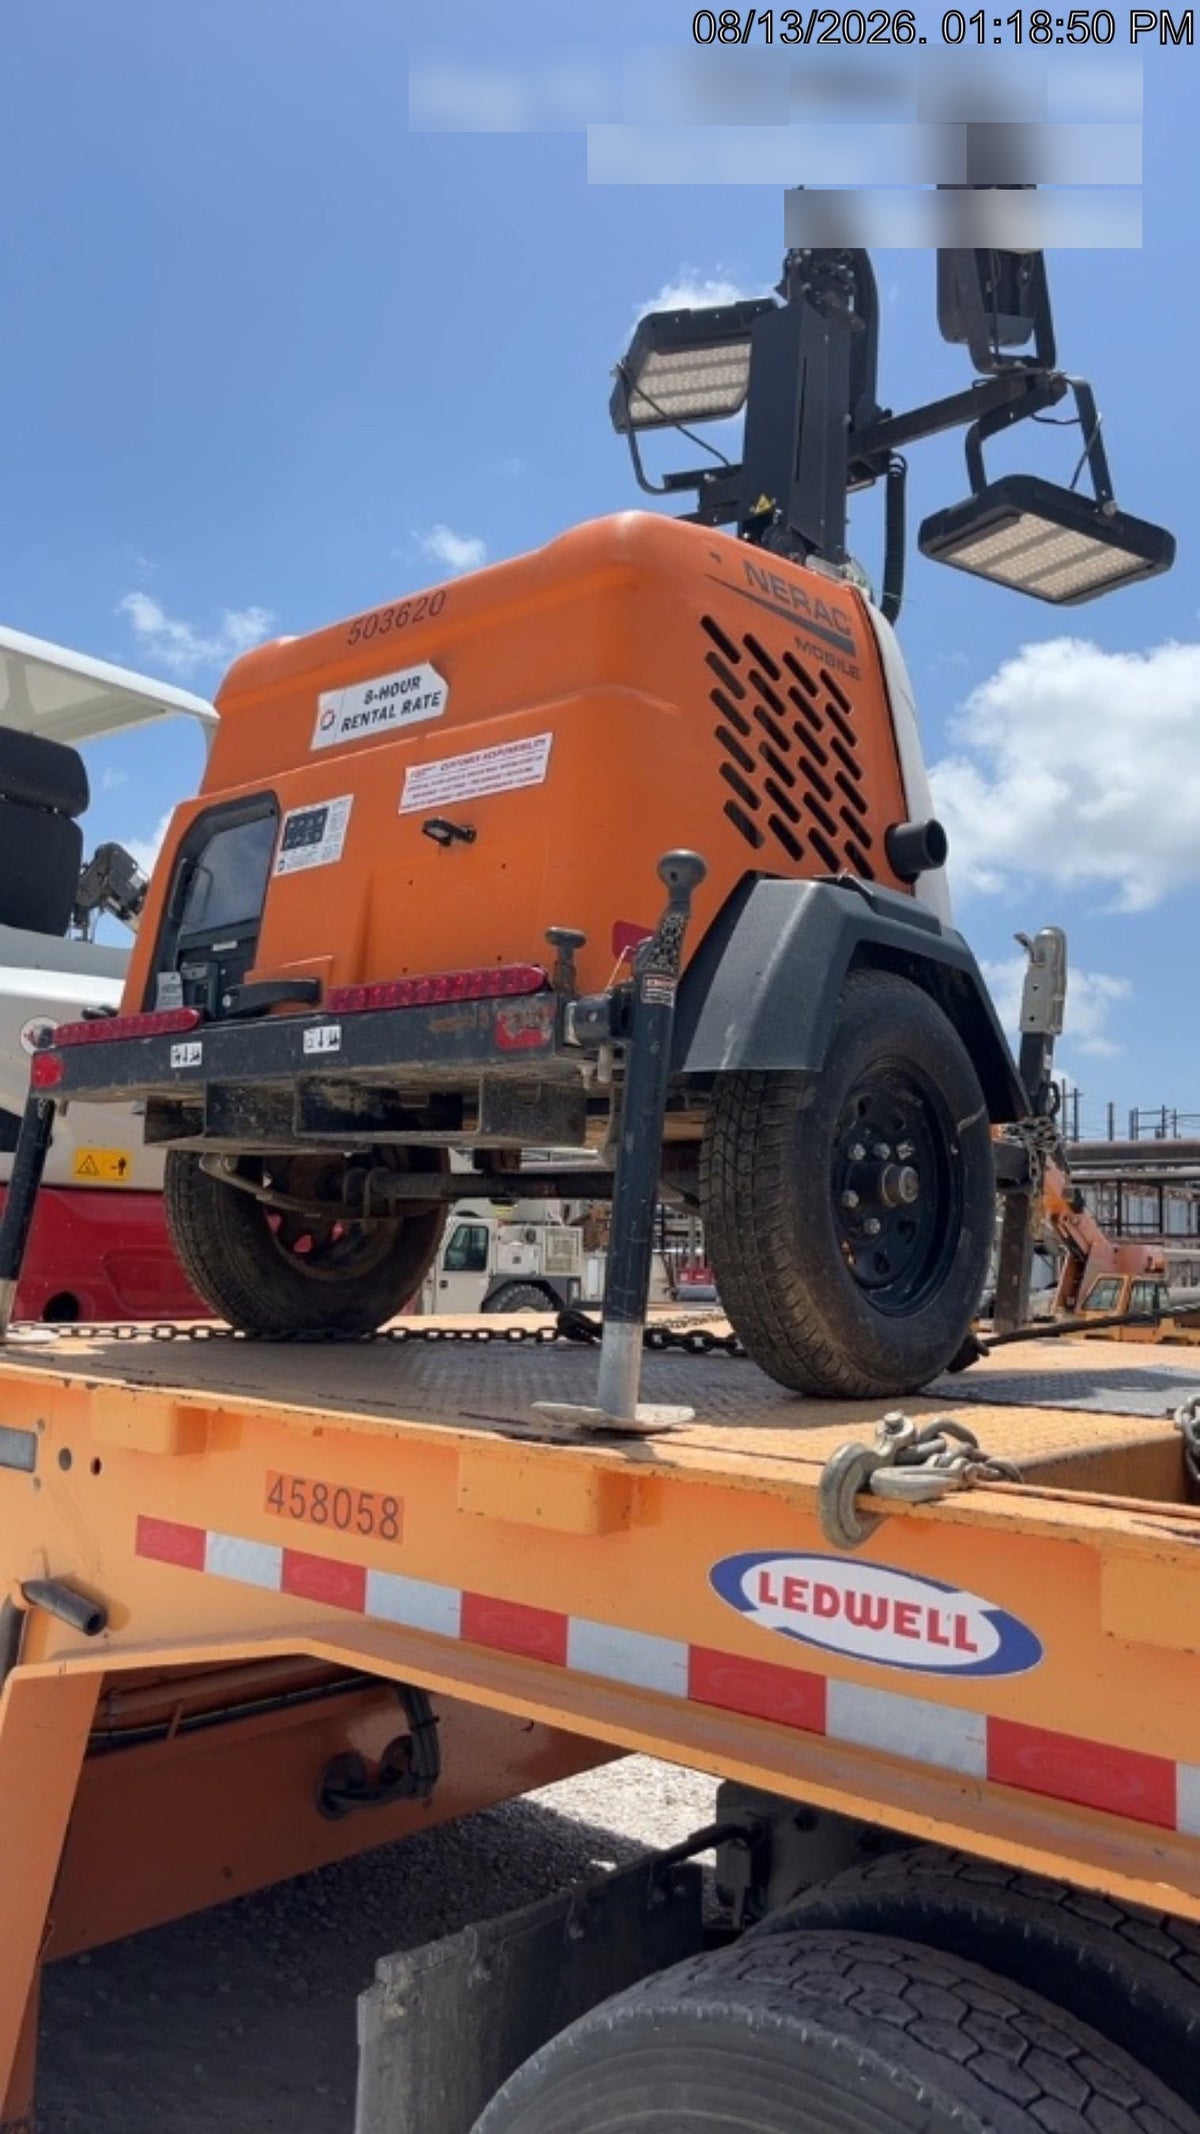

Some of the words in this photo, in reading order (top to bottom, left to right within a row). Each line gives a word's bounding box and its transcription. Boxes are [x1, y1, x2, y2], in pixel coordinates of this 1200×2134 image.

[346, 590, 448, 645] 503620
[341, 704, 397, 733] RENTAL
[401, 691, 442, 715] RATE
[364, 675, 422, 705] 8-HOUR
[266, 1473, 402, 1541] 458058
[758, 1571, 978, 1653] LEDWELL
